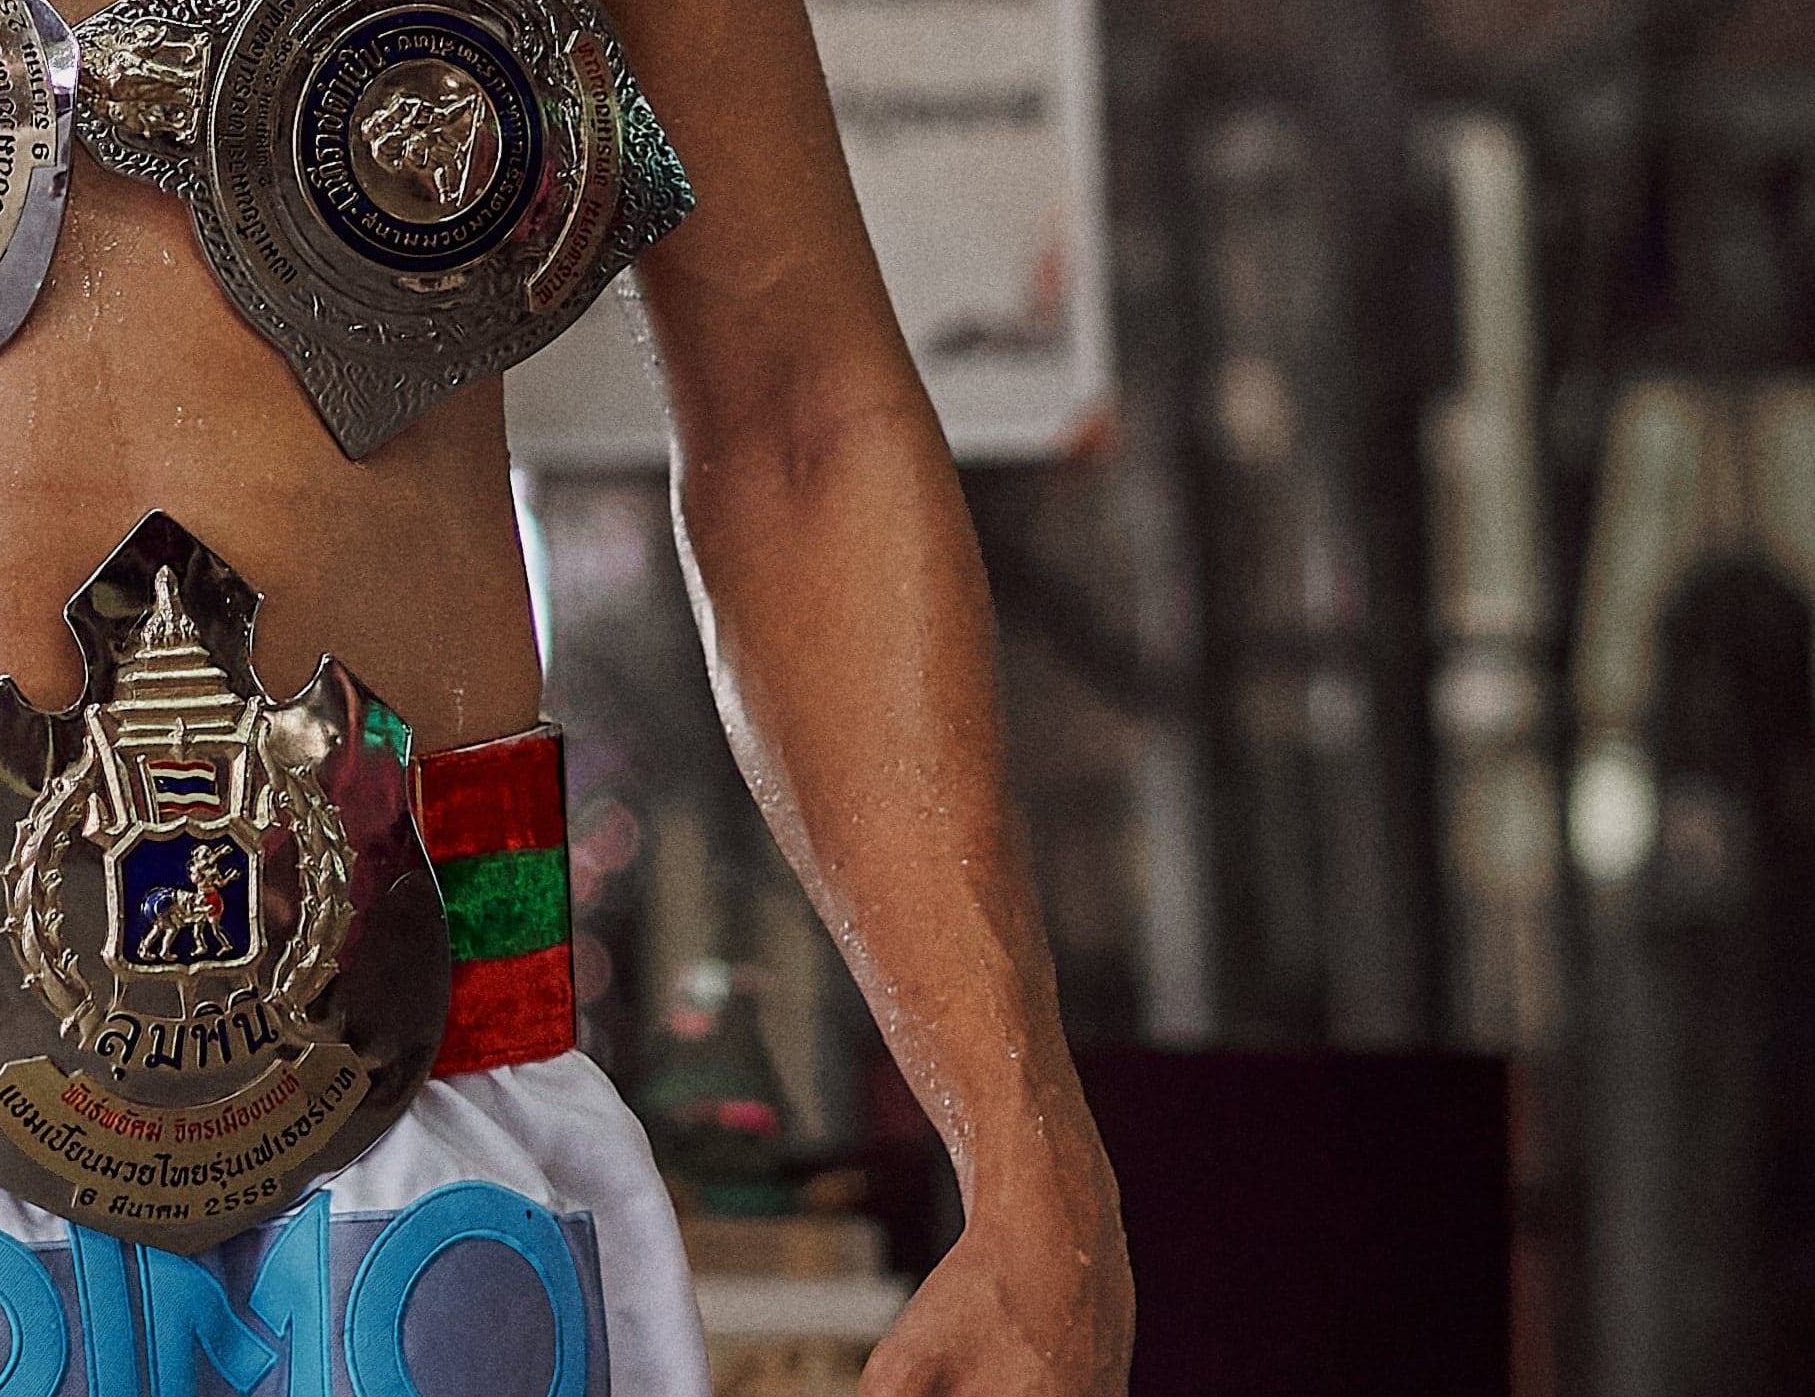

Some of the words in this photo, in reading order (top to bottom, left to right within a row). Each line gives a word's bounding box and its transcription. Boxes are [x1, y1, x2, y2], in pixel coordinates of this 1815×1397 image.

[23, 42, 50, 130] ธันวาคม
[31, 143, 50, 160] 9
[95, 988, 279, 1080] ลุมพินี
[174, 1069, 300, 1143] จิตรเมืองนนท์
[79, 1188, 95, 1205] 6
[108, 1195, 189, 1219] มีนาคม
[204, 1177, 280, 1216] 2558
